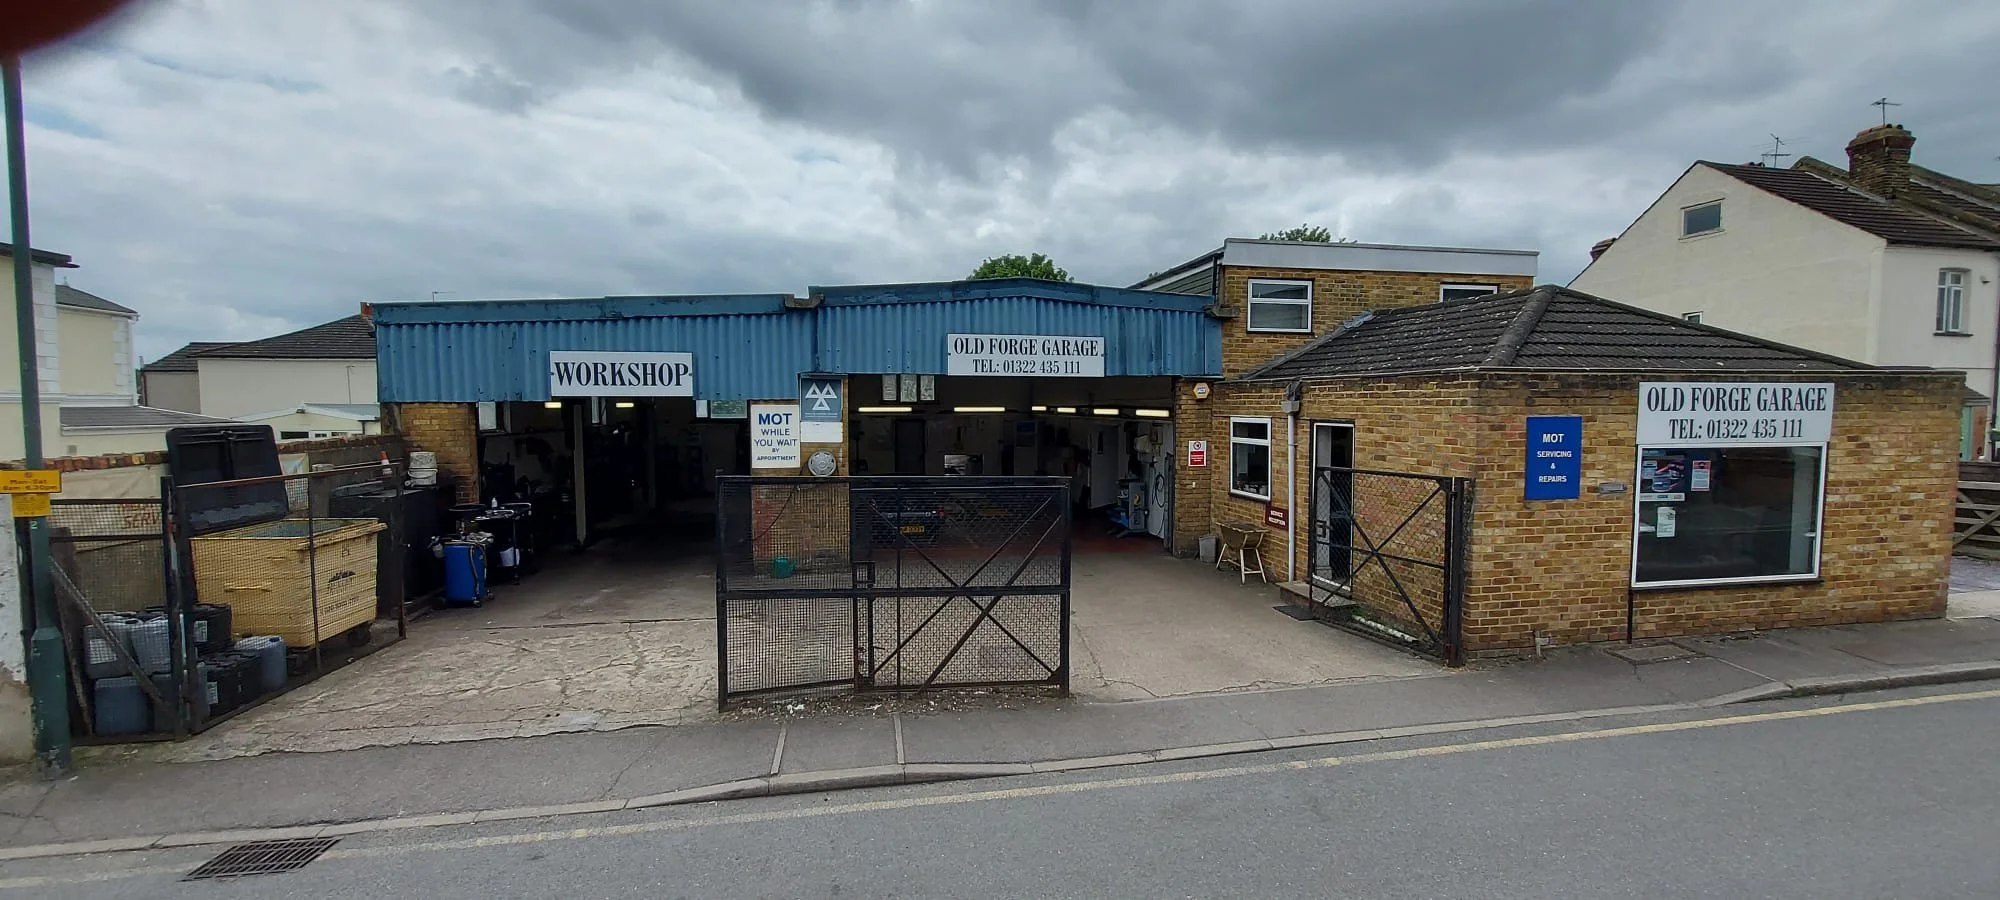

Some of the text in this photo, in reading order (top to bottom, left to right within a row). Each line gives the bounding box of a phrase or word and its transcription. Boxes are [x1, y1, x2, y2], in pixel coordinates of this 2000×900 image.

[954, 337, 1099, 357] OLD FORGE GARAGE
[972, 358, 1081, 374] TEL: 01322 435 111
[554, 361, 690, 387] WORKSHOP
[1647, 386, 1827, 412] OLD FORGE GARAGE
[758, 413, 792, 425] MOT
[761, 428, 790, 436] WHILE
[1669, 418, 1803, 440] TEL: 01322 435 111
[754, 439, 773, 447] YOU
[1542, 433, 1565, 443] MOT
[1536, 450, 1572, 458] SERVICING
[1550, 462, 1556, 470] &
[1538, 475, 1567, 483] REPAIRS
